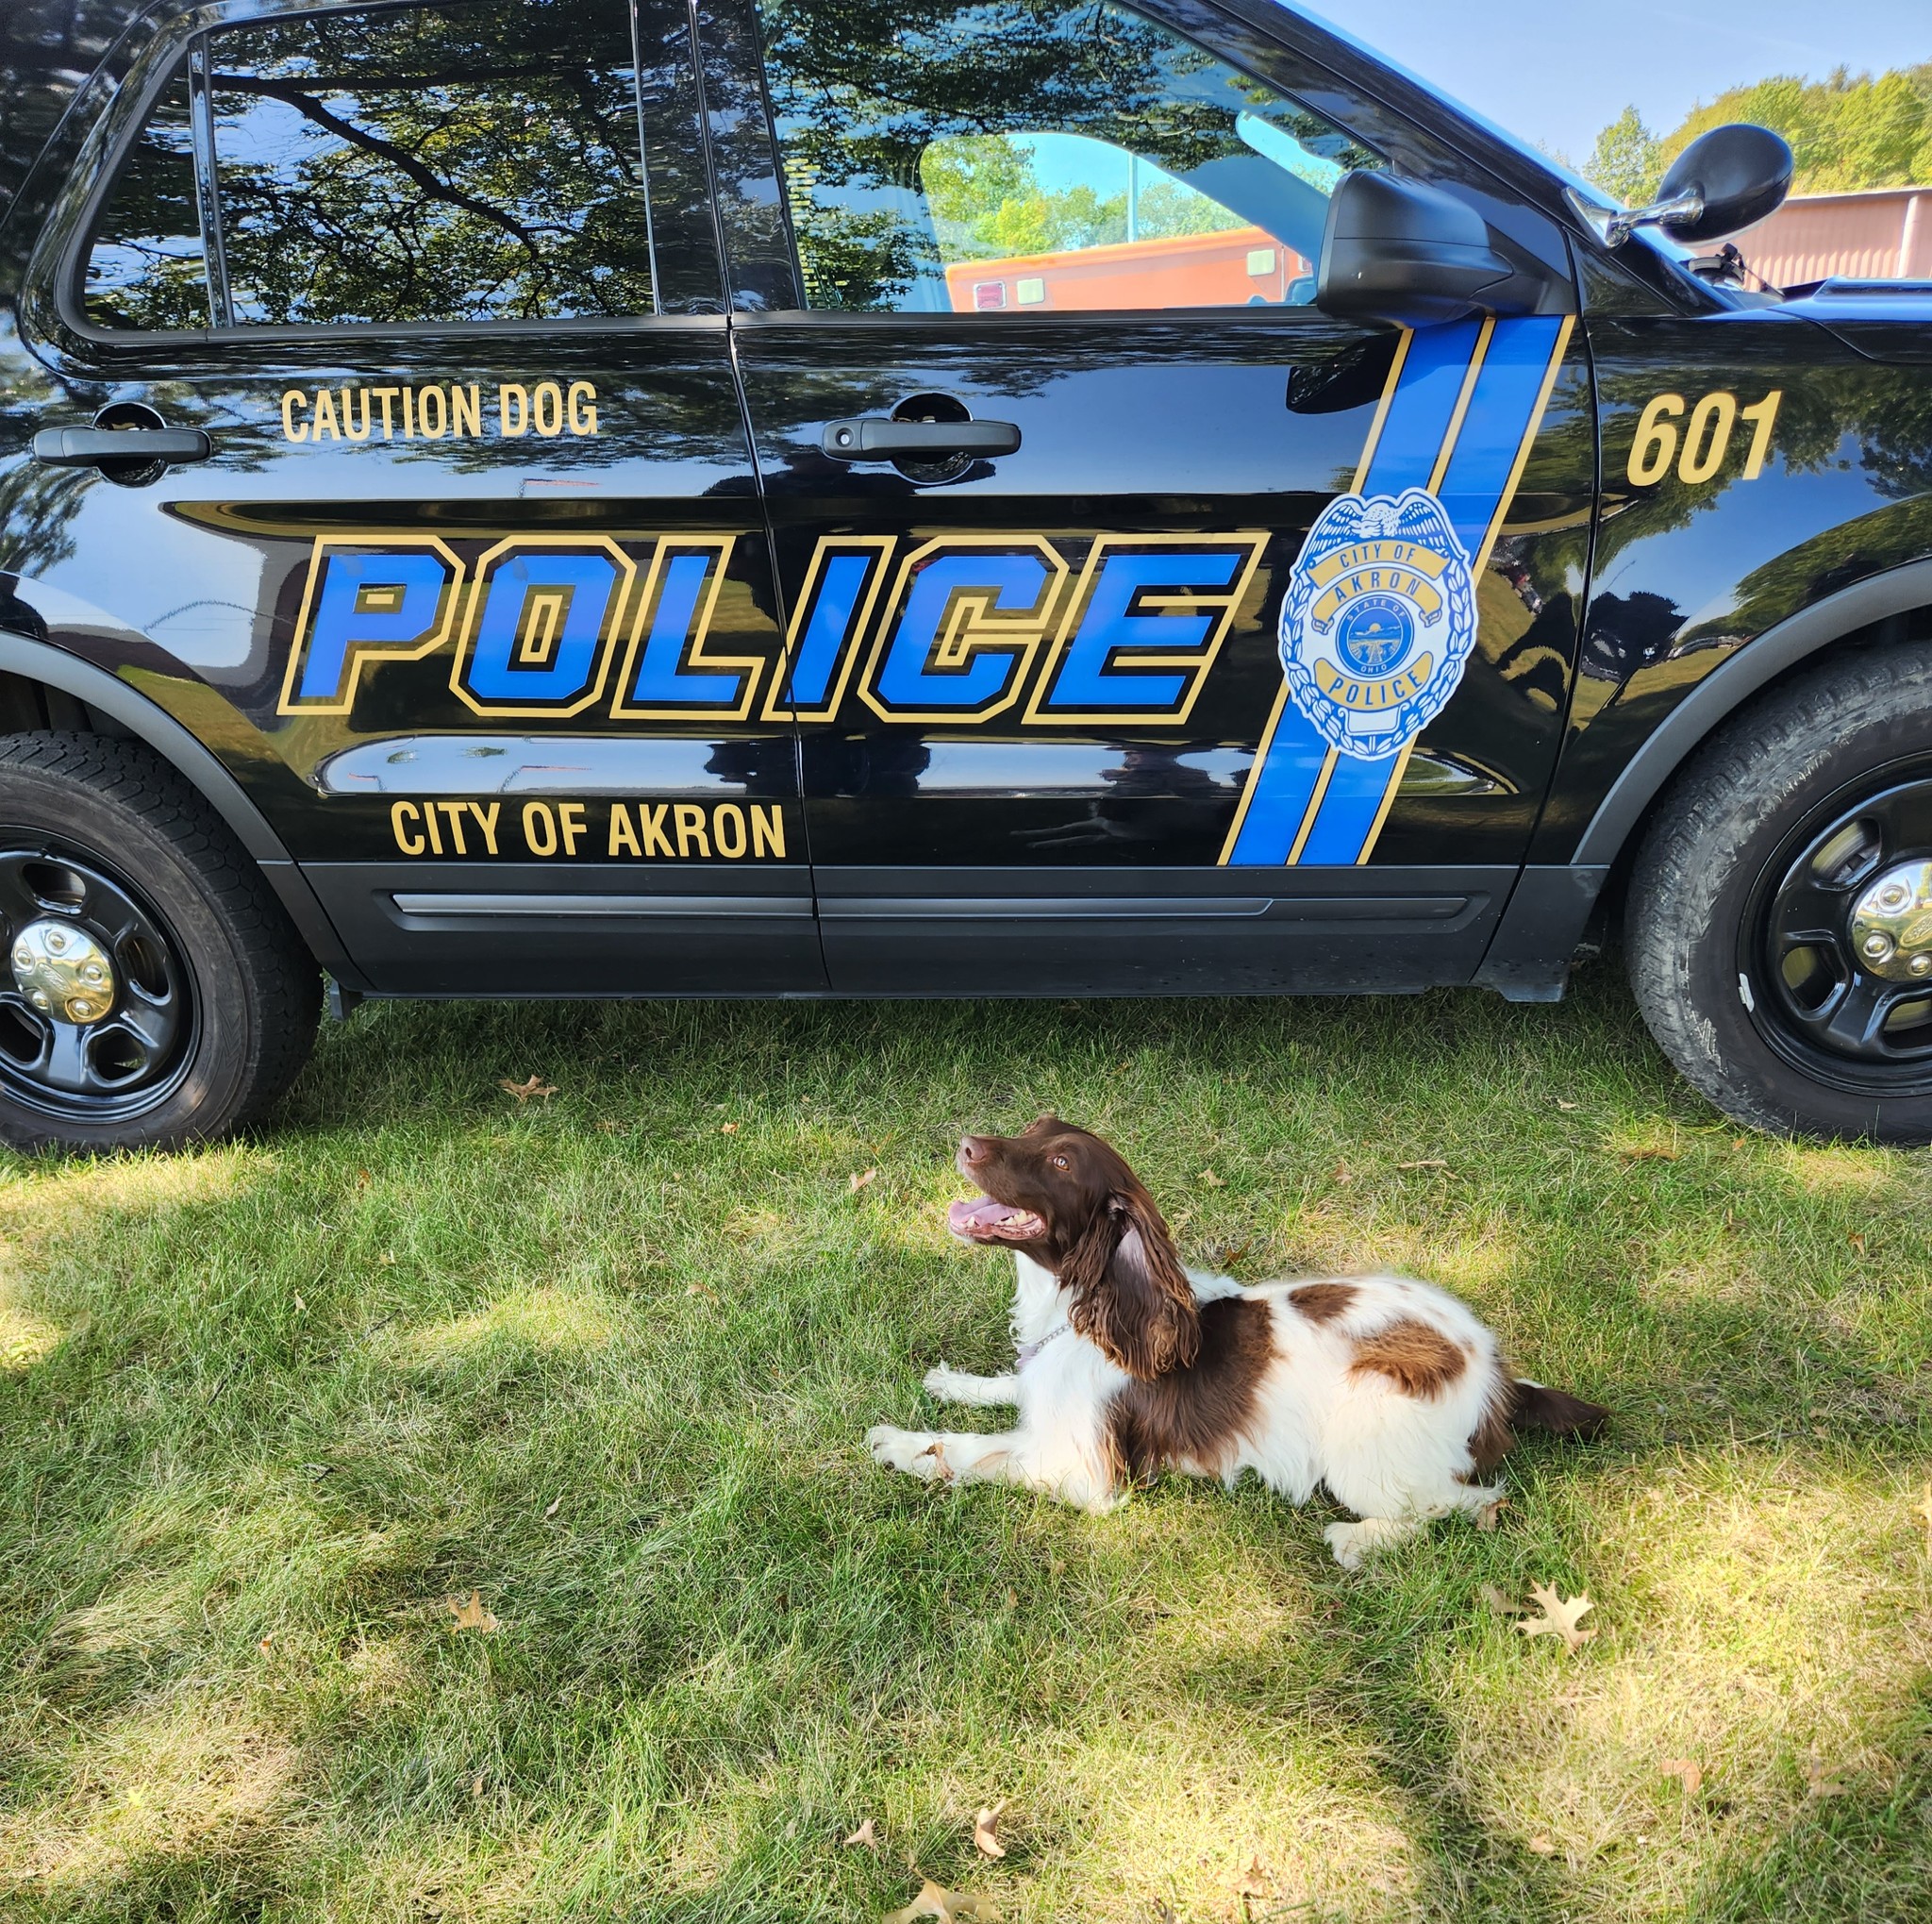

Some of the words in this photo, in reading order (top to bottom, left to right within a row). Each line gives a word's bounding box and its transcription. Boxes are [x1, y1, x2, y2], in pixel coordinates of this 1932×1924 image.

[282, 384, 481, 443] CAUTION
[500, 380, 598, 437] DOG
[1626, 390, 1782, 487] 601
[1340, 544, 1381, 568] CITY
[1393, 544, 1416, 562] OF
[1334, 571, 1421, 602] AKRON
[276, 532, 1272, 724] POLICE
[1347, 599, 1387, 622] STATE
[1392, 604, 1406, 618] OF
[1360, 663, 1388, 674] OHIO
[1327, 670, 1423, 706] POLICE
[391, 800, 501, 857] CITY
[522, 801, 588, 857] OF
[608, 803, 787, 859] AKRON
